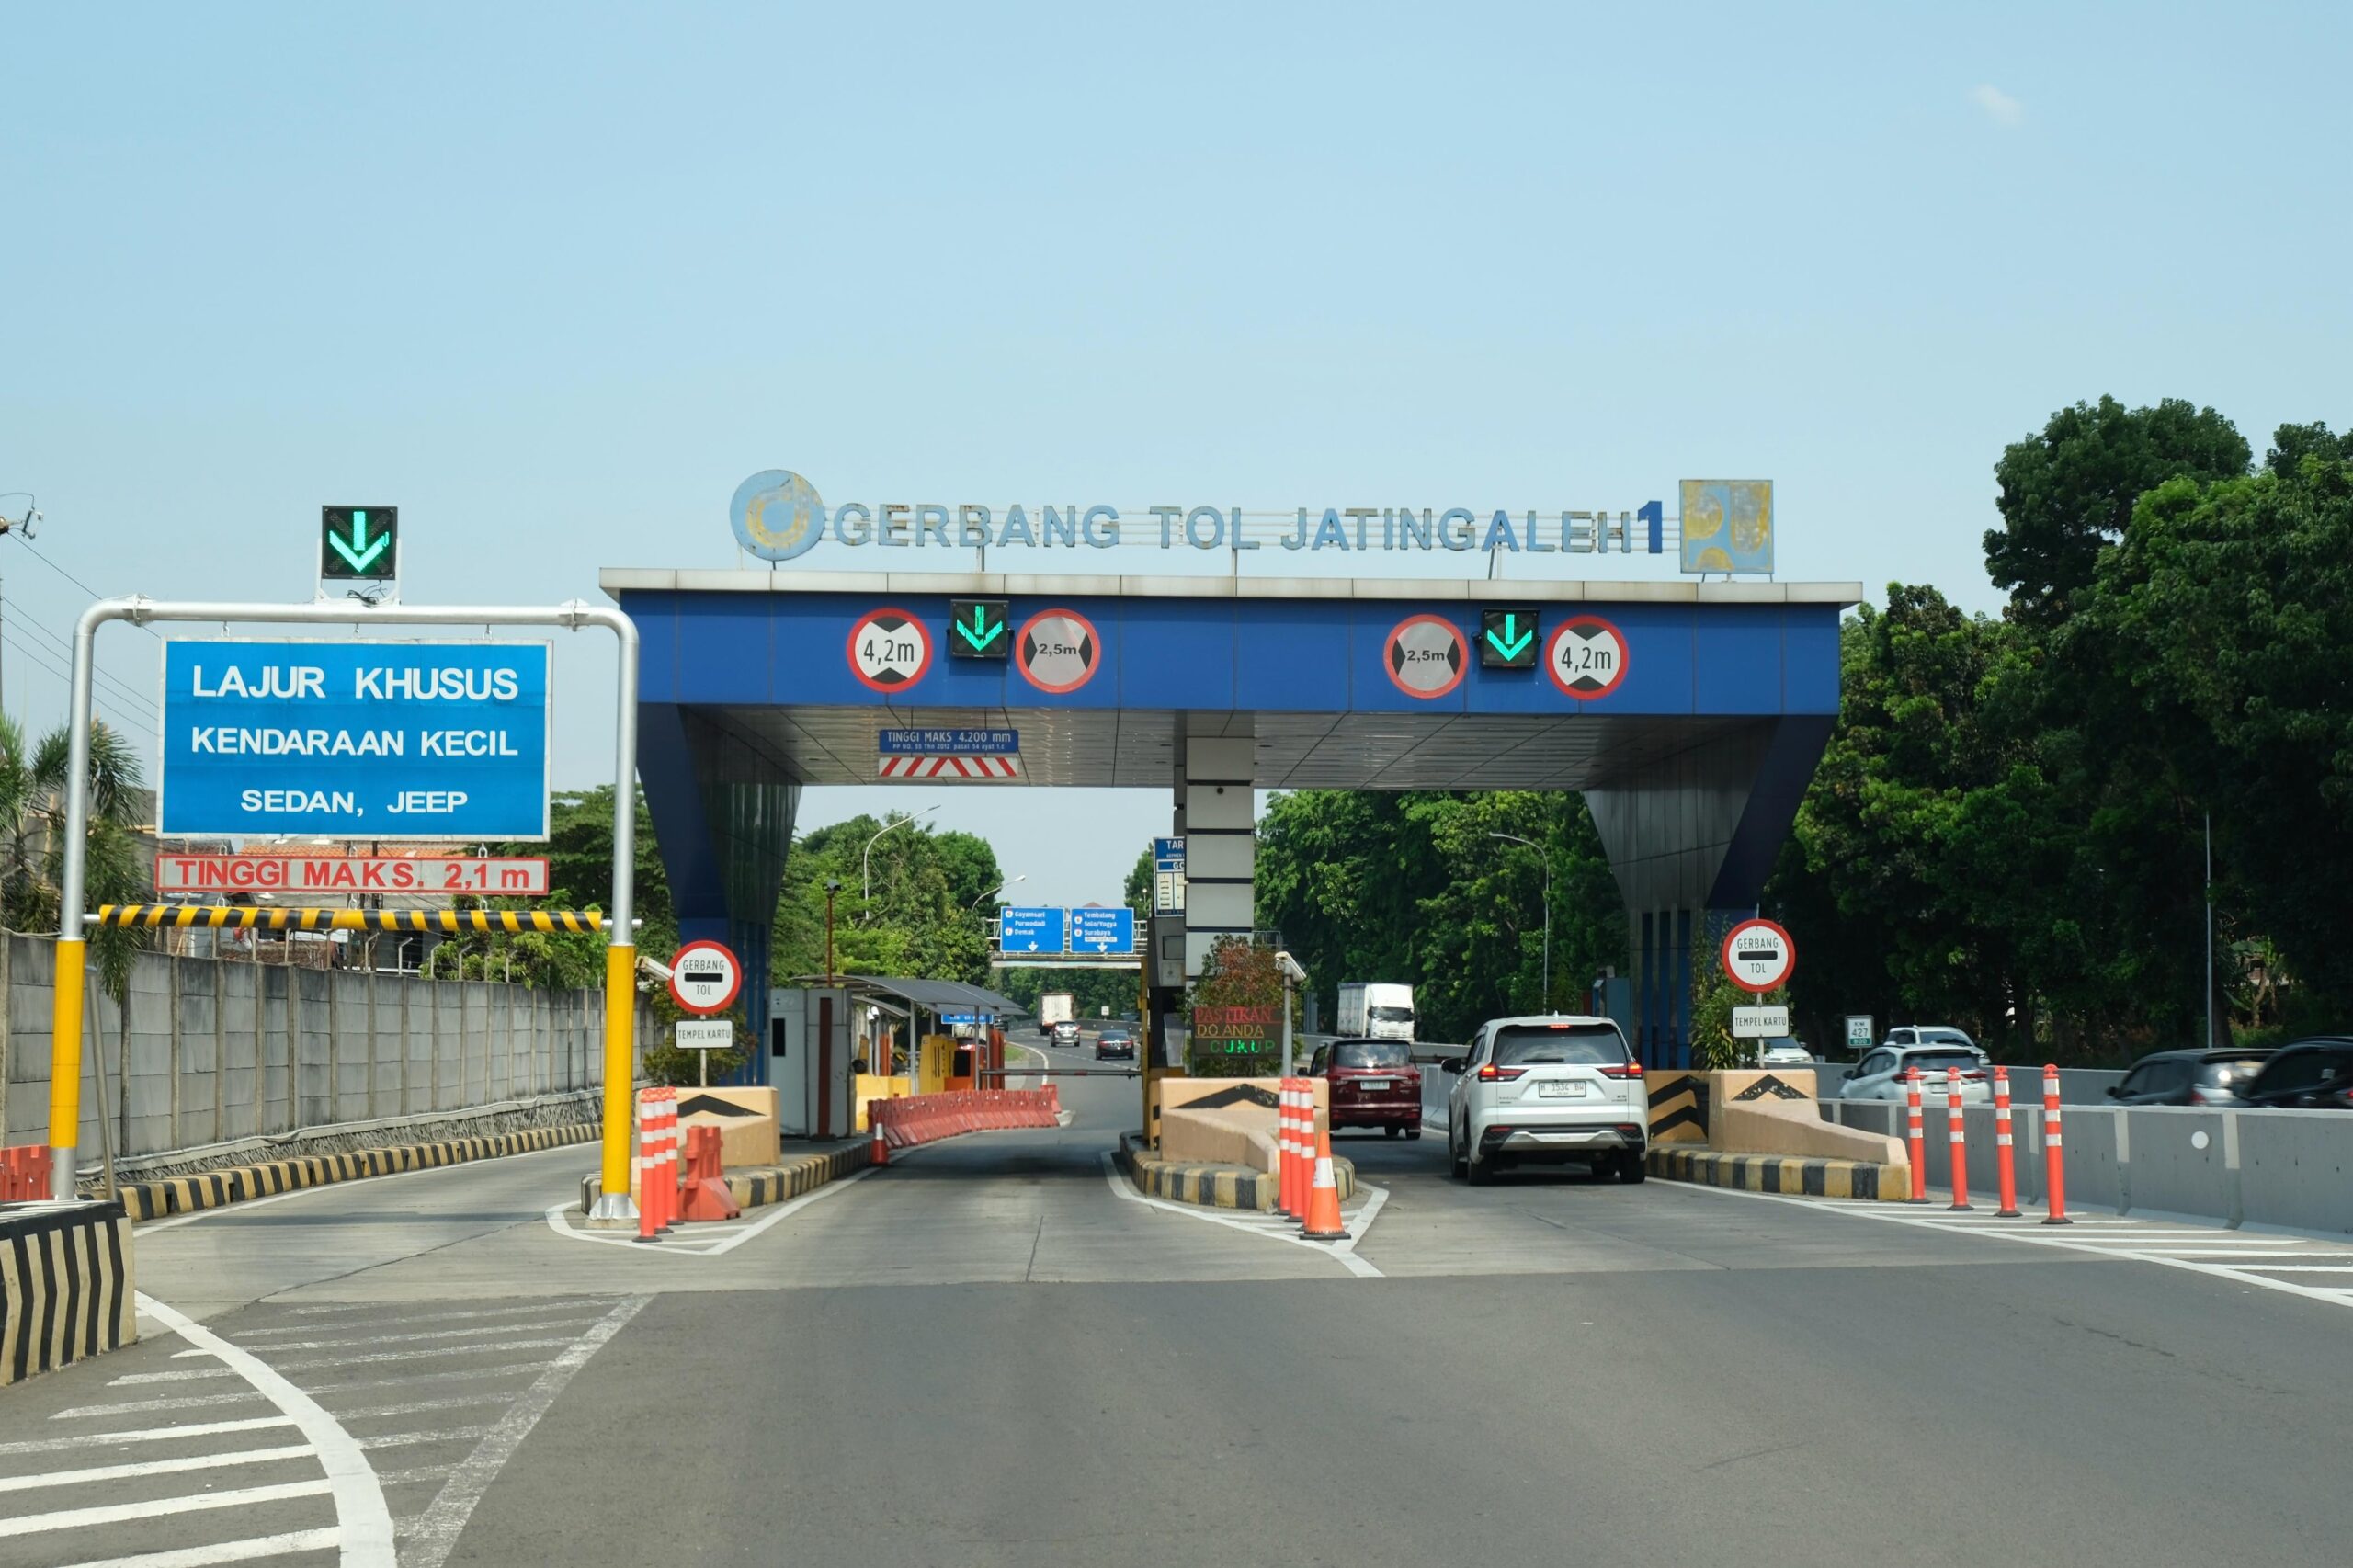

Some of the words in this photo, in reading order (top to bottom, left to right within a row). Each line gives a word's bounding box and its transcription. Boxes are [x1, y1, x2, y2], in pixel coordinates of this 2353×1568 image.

[833, 502, 1120, 549] GERBANG
[1149, 506, 1261, 550] TOL
[1280, 506, 1631, 554] JATINGALEH
[1637, 500, 1663, 554] 1
[863, 637, 915, 665] 4,2m
[1038, 643, 1077, 658] 2,5m
[1406, 649, 1446, 665] 2,5m
[1561, 645, 1612, 673] 4,2m
[192, 665, 325, 699] LAJUR
[355, 667, 518, 700] KHUSUS
[191, 726, 404, 756] KENDARAAN
[420, 729, 518, 756] KECIL
[887, 731, 919, 743] TINGGI
[924, 731, 952, 743] MAKS
[958, 731, 987, 743] 4.200
[992, 733, 1011, 743] mm
[240, 789, 363, 817] SEDAN,
[387, 790, 469, 814] JEEP
[1165, 840, 1184, 850] TAR
[175, 859, 290, 888] TINGGI
[303, 862, 424, 889] MAKS.
[443, 863, 490, 892] 2,1
[502, 869, 530, 889] m
[1736, 937, 1779, 949] GERBANG
[682, 960, 725, 971] GERBANG
[1750, 962, 1767, 974] TOL
[696, 984, 711, 995] TOL
[1195, 1006, 1272, 1022] PASTIKAN
[1734, 1017, 1762, 1027] TEMPEL
[1763, 1017, 1787, 1026] KARTU
[677, 1029, 705, 1040] TEMPEL
[707, 1028, 731, 1039] KARTU
[1222, 1023, 1265, 1037] ANDA
[1851, 1028, 1869, 1038] 427
[1209, 1039, 1276, 1054] CUKUP
